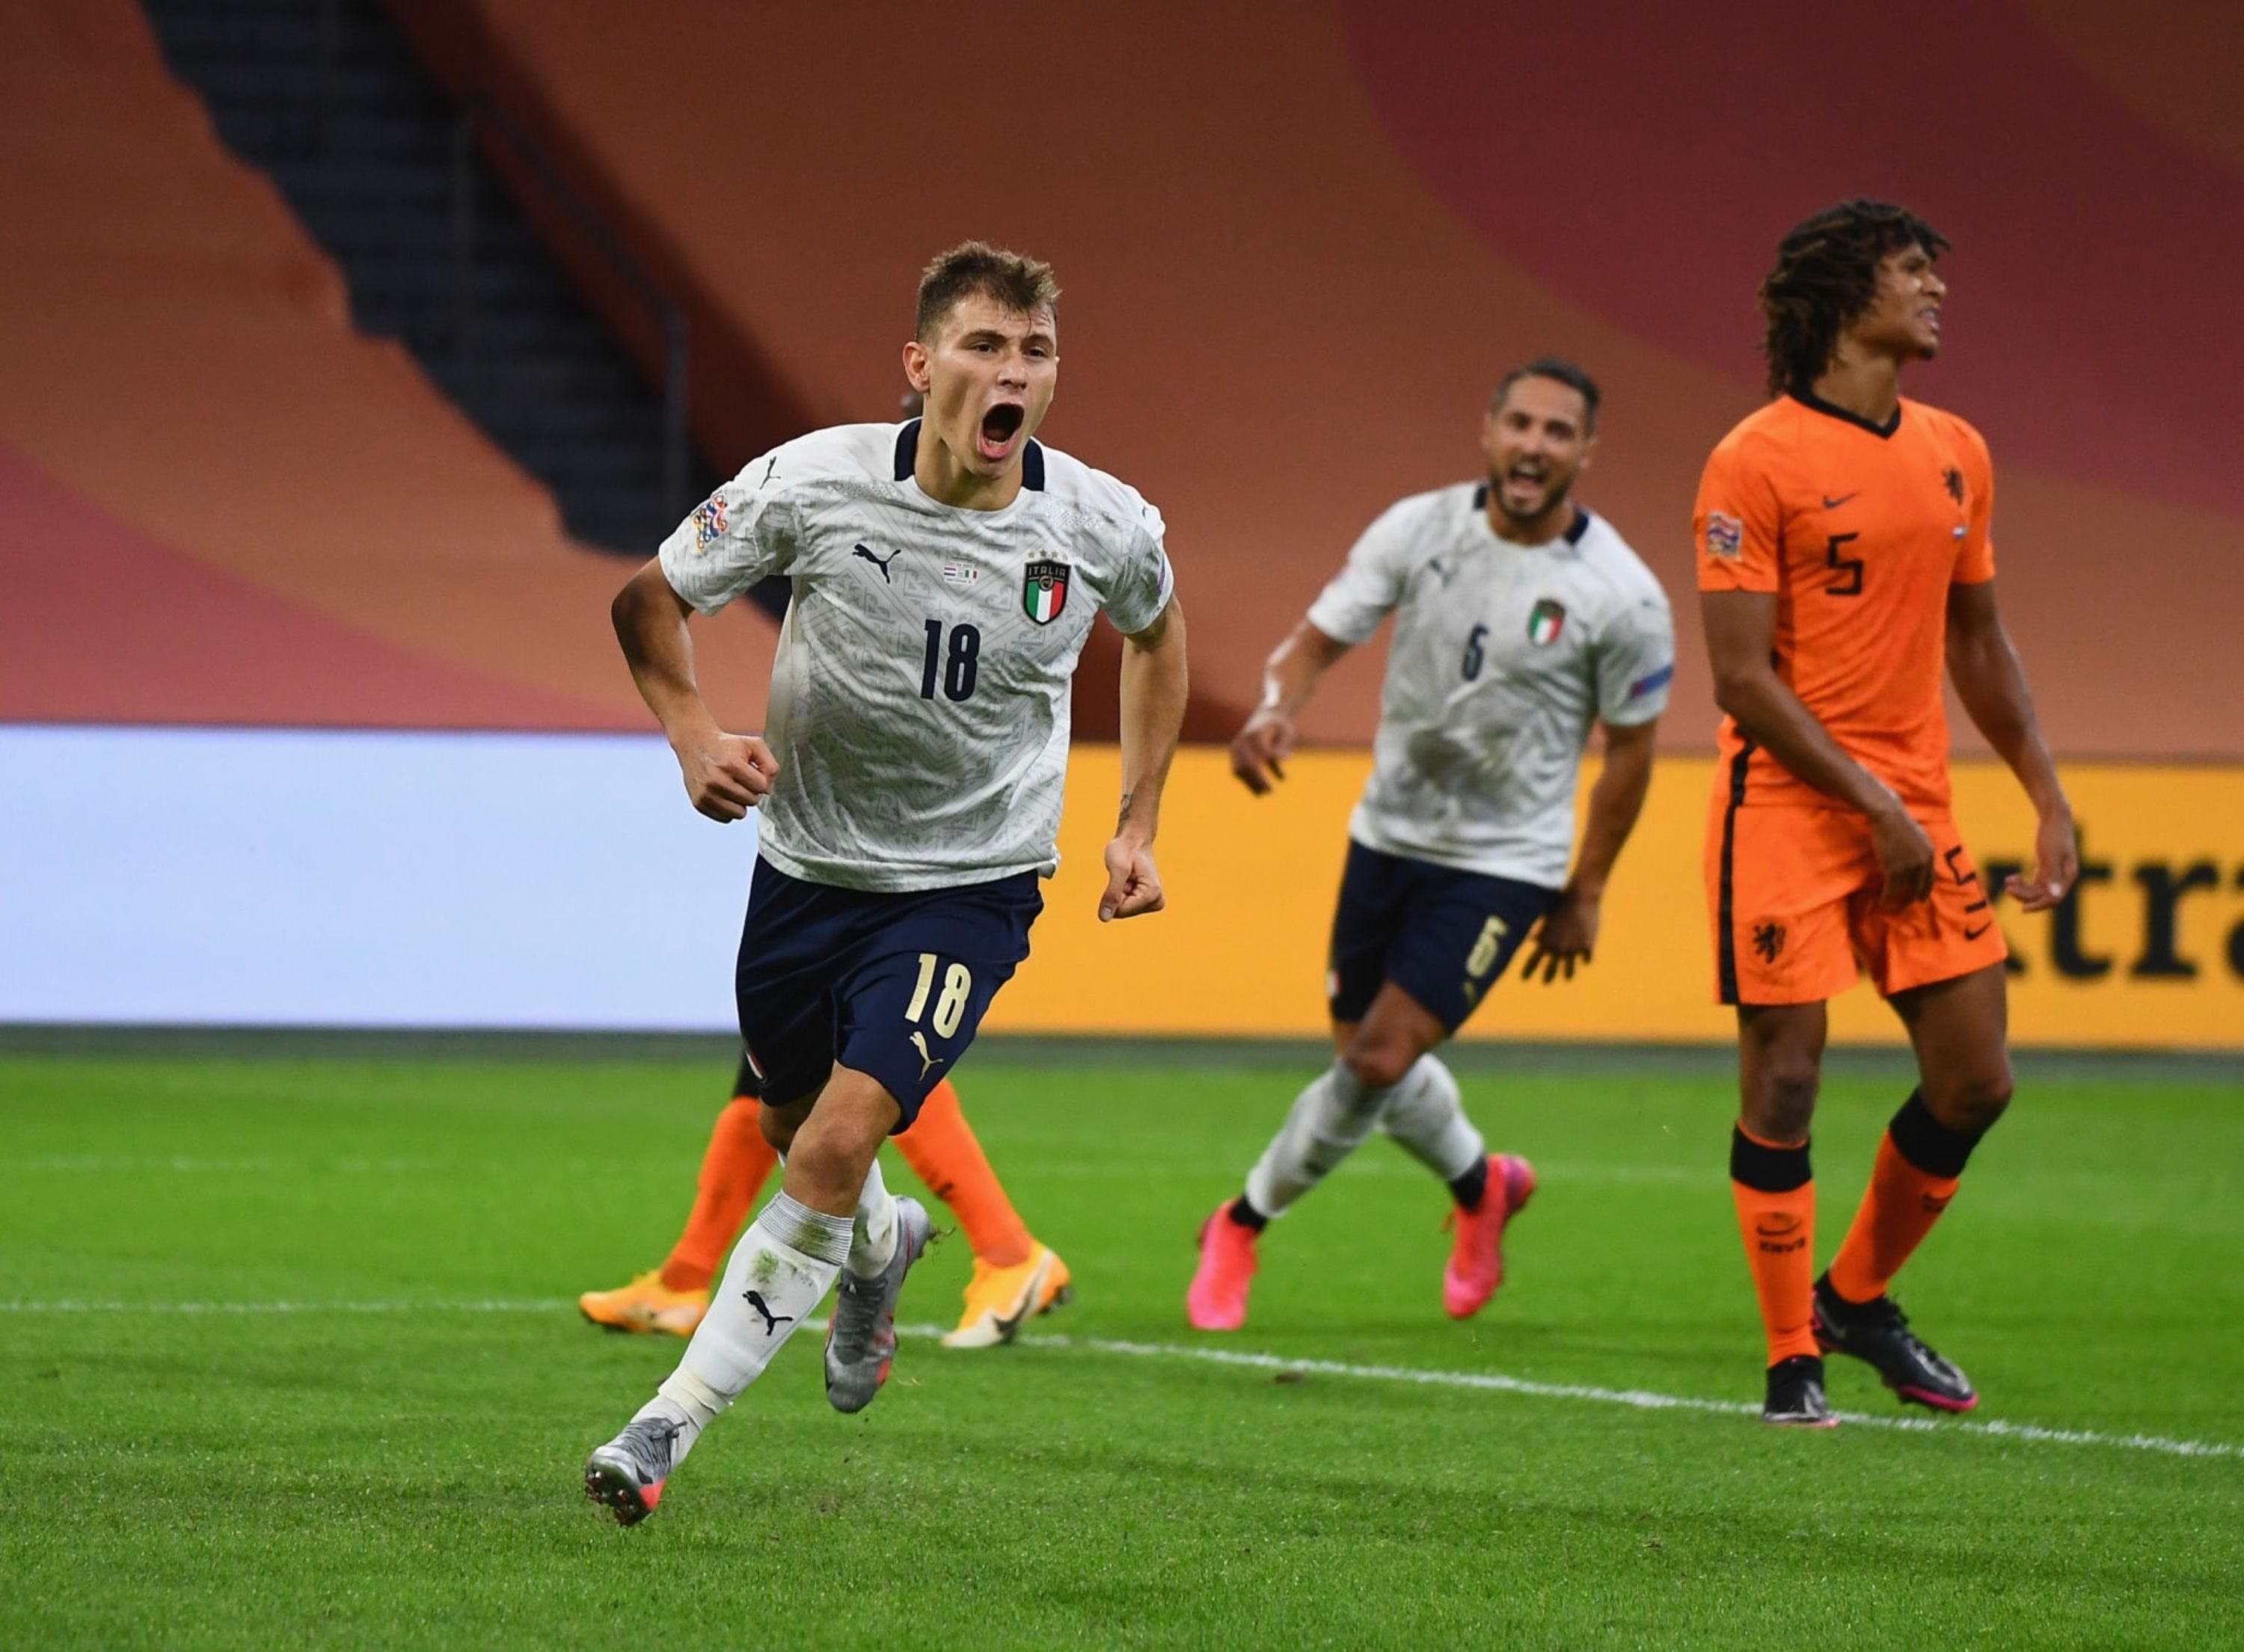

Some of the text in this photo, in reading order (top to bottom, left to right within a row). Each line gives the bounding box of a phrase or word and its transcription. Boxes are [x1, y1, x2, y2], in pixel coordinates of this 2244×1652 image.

[1028, 565, 1066, 577] ITALIA
[1827, 531, 1863, 595] 5
[920, 618, 981, 701] 18
[1461, 622, 1489, 682] 6
[1465, 914, 1508, 977] 6
[904, 953, 972, 1039] 18
